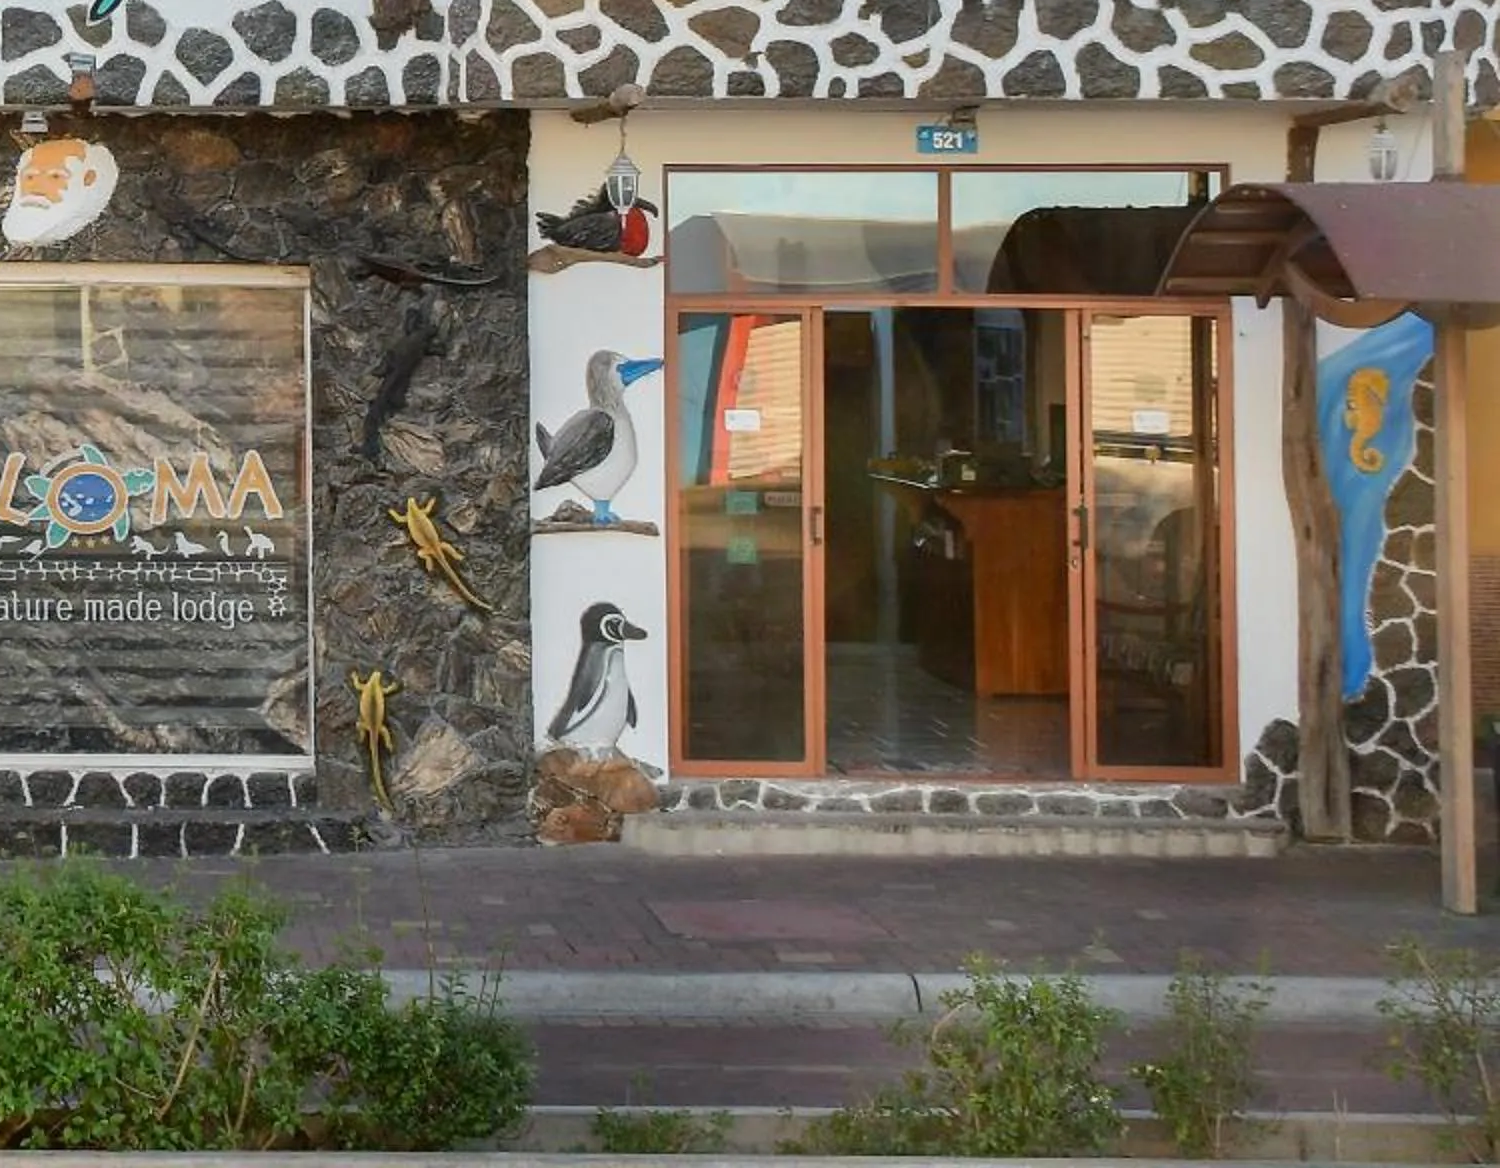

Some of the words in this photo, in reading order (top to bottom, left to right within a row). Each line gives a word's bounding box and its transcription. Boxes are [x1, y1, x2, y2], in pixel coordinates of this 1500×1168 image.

[932, 131, 964, 149] 521
[83, 589, 162, 621] made
[172, 589, 255, 628] lodge
